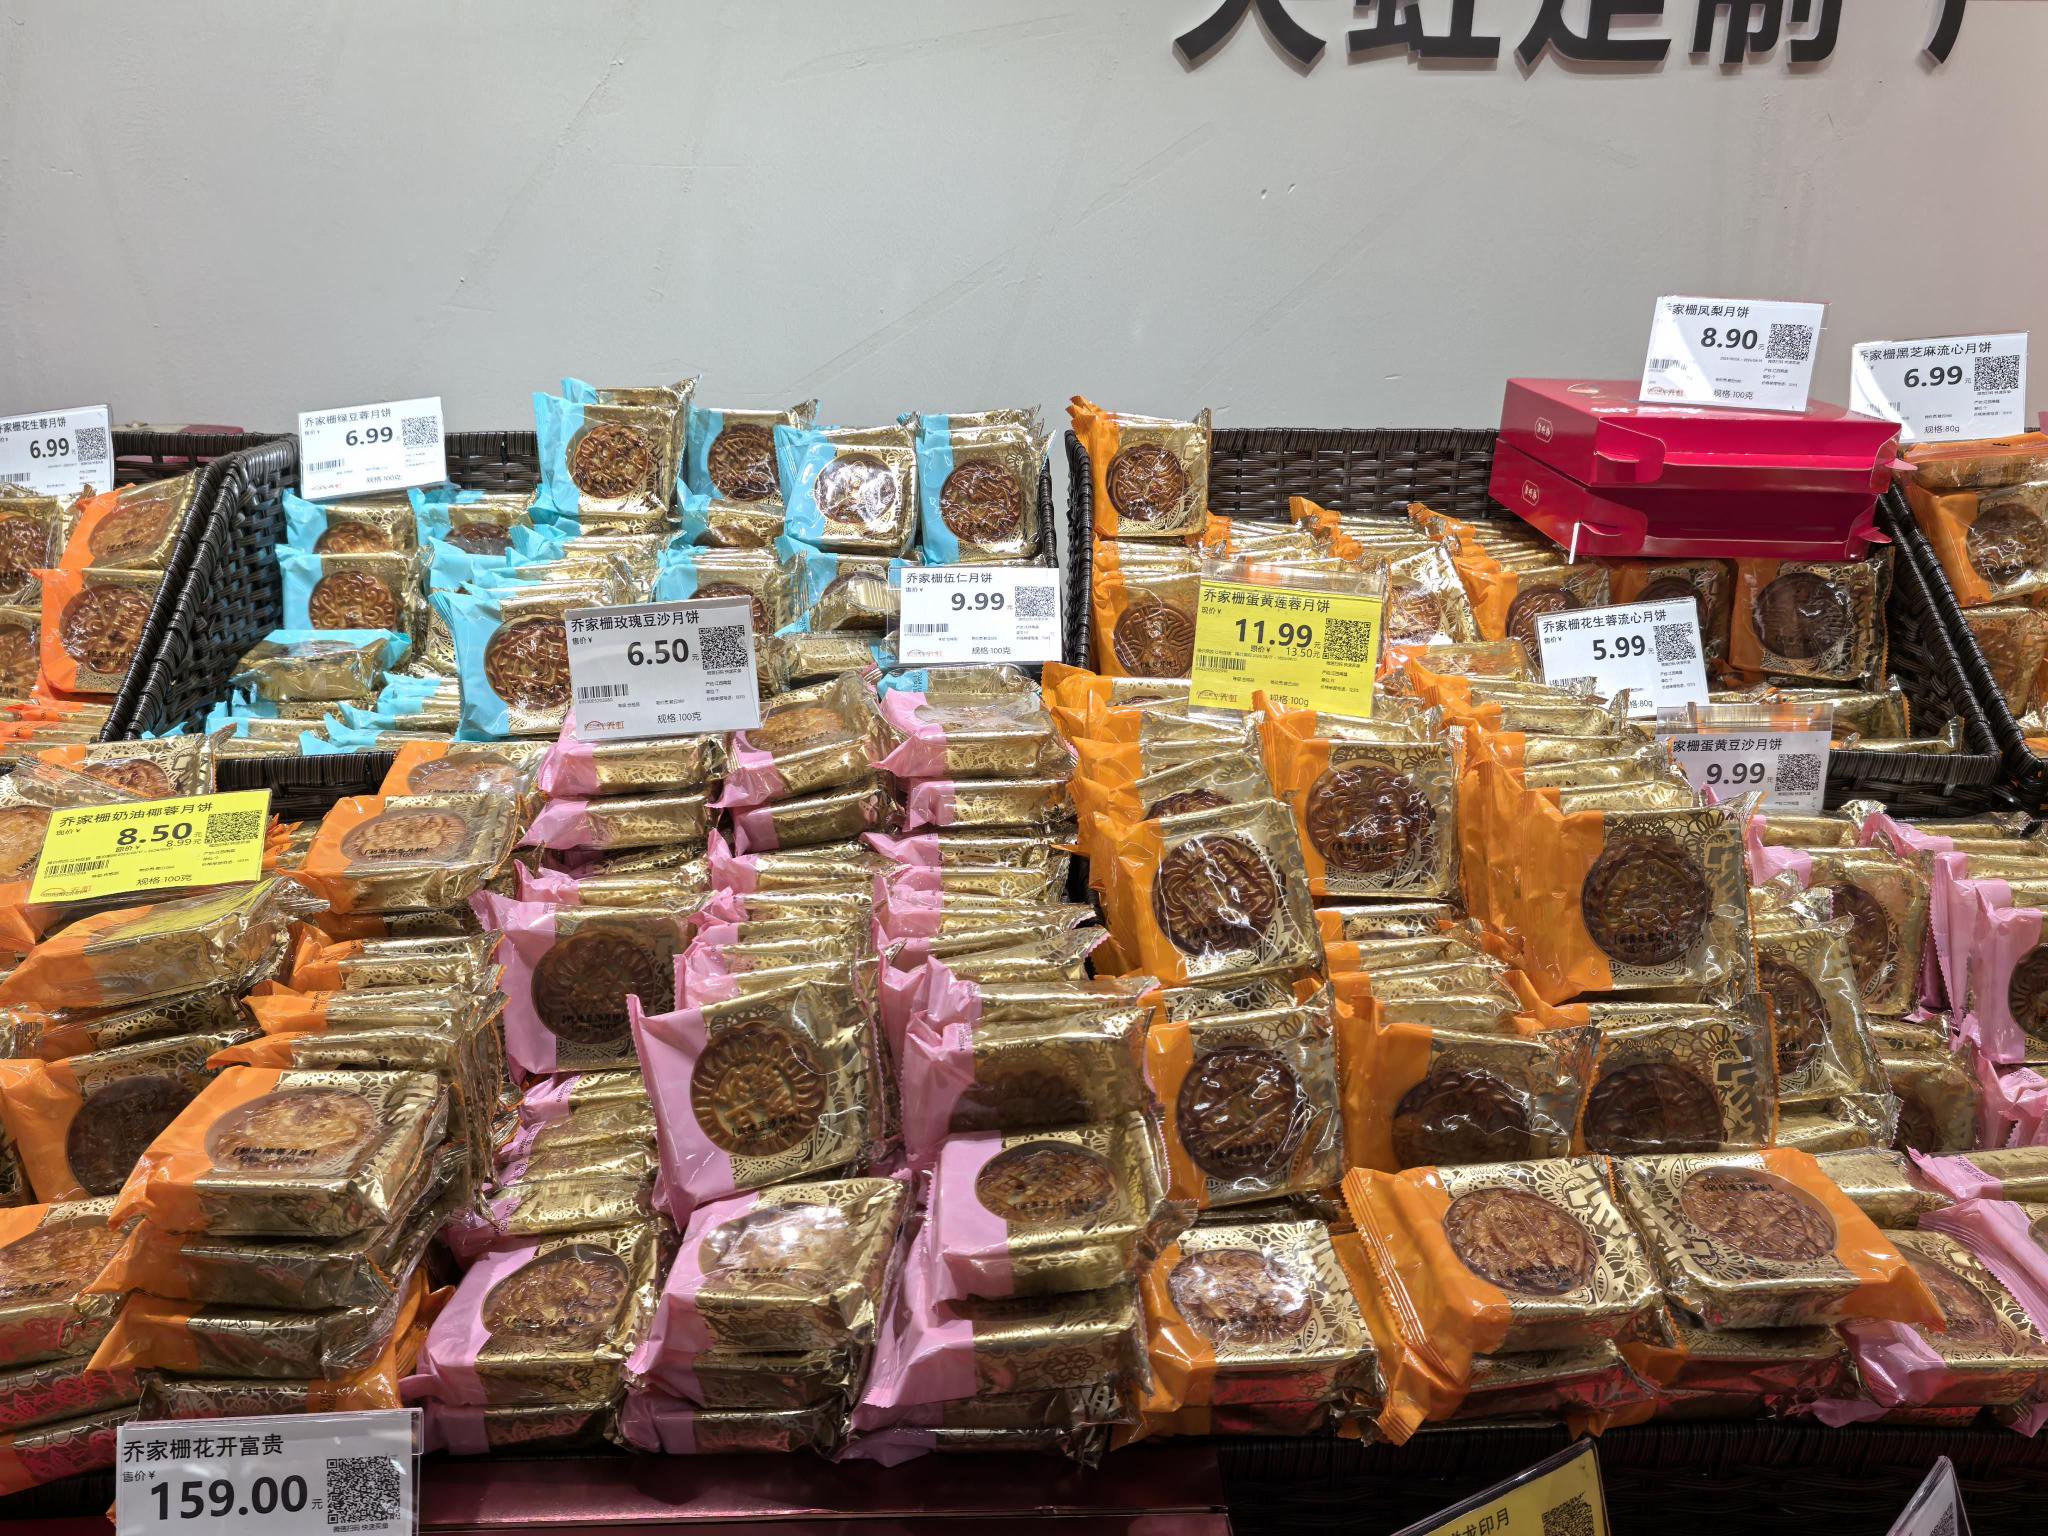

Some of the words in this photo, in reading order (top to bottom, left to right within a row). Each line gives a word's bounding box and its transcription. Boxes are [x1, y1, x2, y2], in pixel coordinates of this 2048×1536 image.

[1667, 303, 1749, 318] 家栅凤梨月饼
[1700, 327, 1758, 350] 8.90
[1904, 365, 1962, 388] 6.99
[0, 416, 66, 434] 家栅花生蓉月饼
[304, 408, 392, 427] 乔家栅绿豆蓉月饼
[345, 426, 393, 446] 6.99
[30, 437, 69, 459] 6.99
[906, 572, 993, 584] 乔家栅伍仁月饼
[951, 592, 1005, 611] 9.99
[1203, 588, 1331, 614] 乔家栅蛋黄莲蓉月饼
[571, 610, 700, 633] 乔家栅玫瑰豆沙月饼
[1543, 608, 1667, 633] 乔家栅花生蓉流心月饼
[1235, 618, 1313, 648] 11.99
[627, 638, 690, 666] 6.50
[692, 653, 699, 661] 元
[1593, 635, 1646, 661] 5.99
[1629, 700, 1653, 709] 格:80g
[657, 712, 702, 724] 规格:100克
[1673, 738, 1782, 753] 家栅蛋黄豆沙月饼
[1706, 762, 1765, 785] 9.99
[59, 802, 213, 828] 乔家栅奶油椰蓉月饼
[115, 822, 193, 846] 8.50
[165, 838, 193, 848] 8.99
[123, 1433, 284, 1463] 乔家栅花开富贵
[122, 1470, 156, 1483] 售价¥
[151, 1474, 308, 1521] 159.00
[311, 1498, 323, 1510] 元
